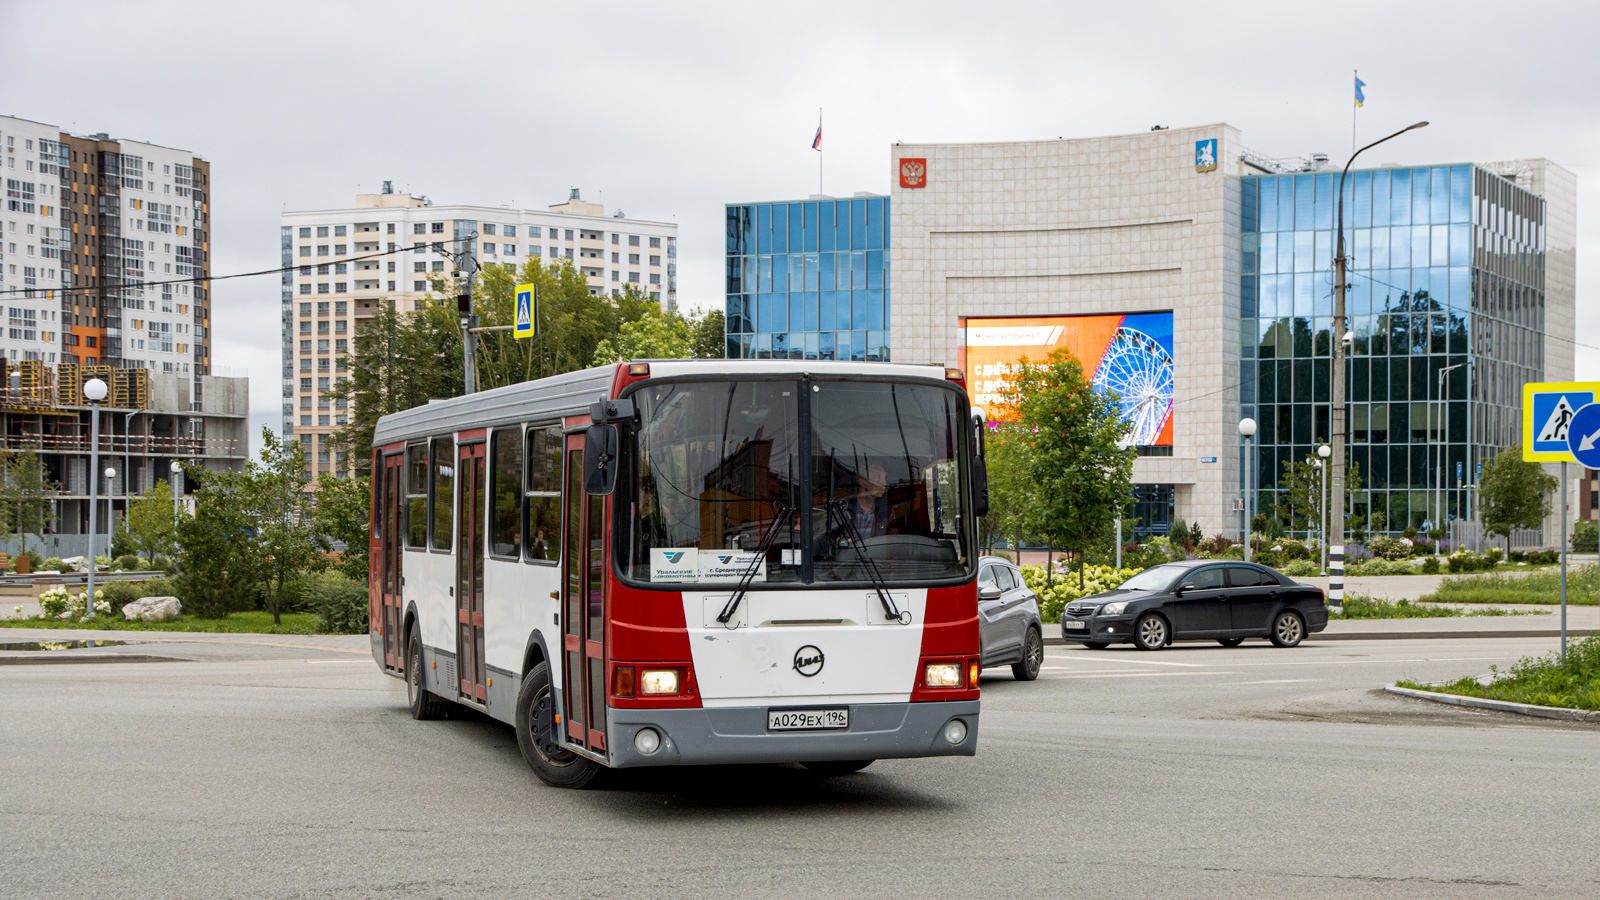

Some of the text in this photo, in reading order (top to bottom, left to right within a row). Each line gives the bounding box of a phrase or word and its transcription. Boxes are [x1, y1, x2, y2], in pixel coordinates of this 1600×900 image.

[975, 365, 981, 376] С
[975, 381, 981, 392] С
[773, 711, 844, 728] А029ЕХ 196
